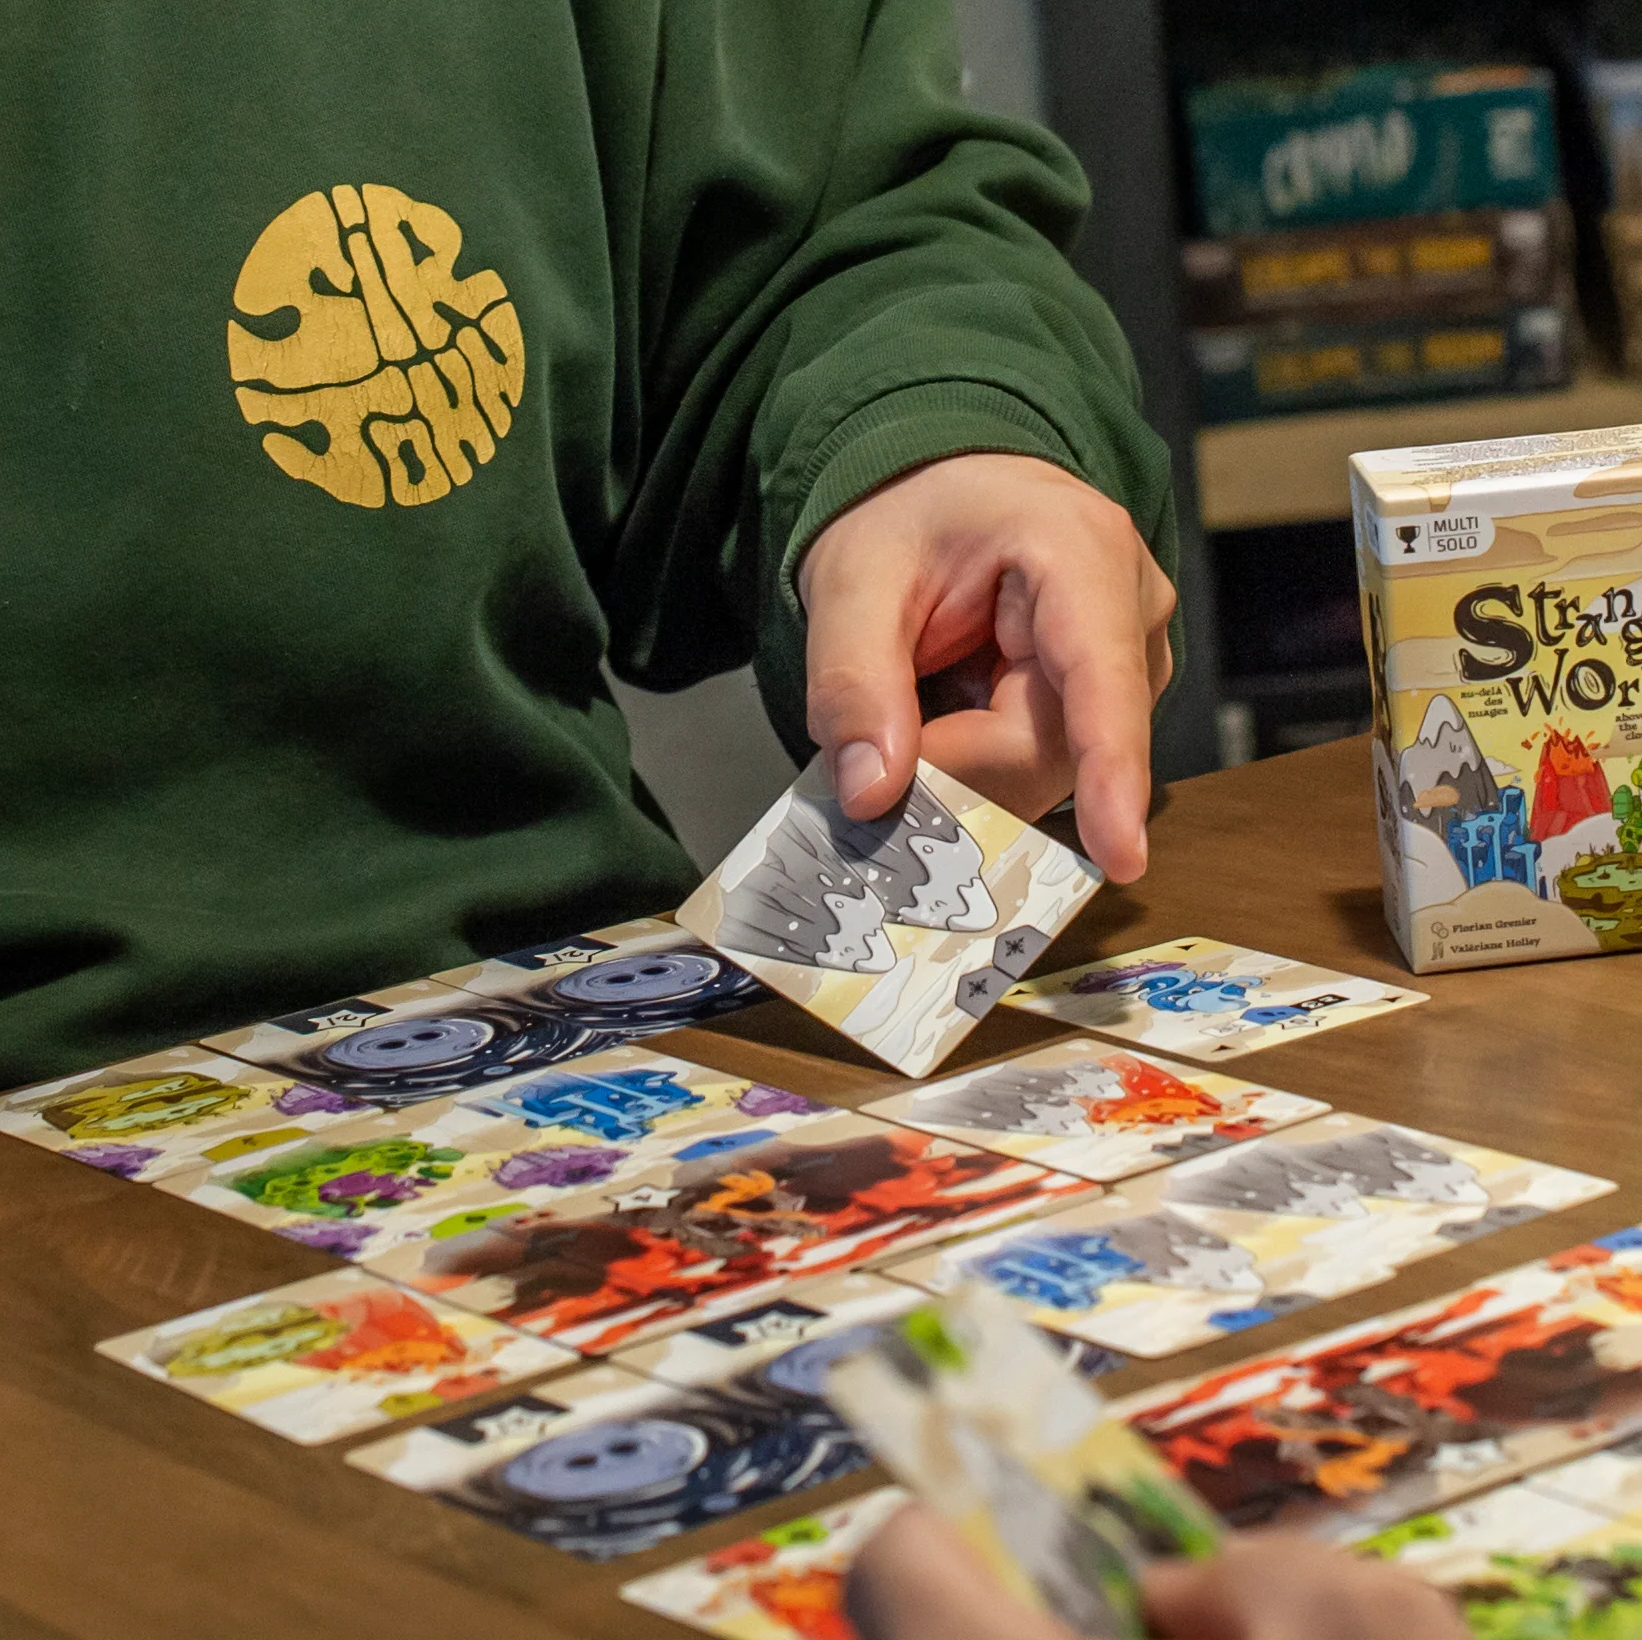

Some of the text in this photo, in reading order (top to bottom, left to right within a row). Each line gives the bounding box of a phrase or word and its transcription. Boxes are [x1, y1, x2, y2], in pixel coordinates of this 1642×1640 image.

[1432, 515, 1480, 534] MULTI
[1435, 535, 1478, 554] SOLO
[1619, 722, 1638, 732] the
[1452, 922, 1493, 933] Florian
